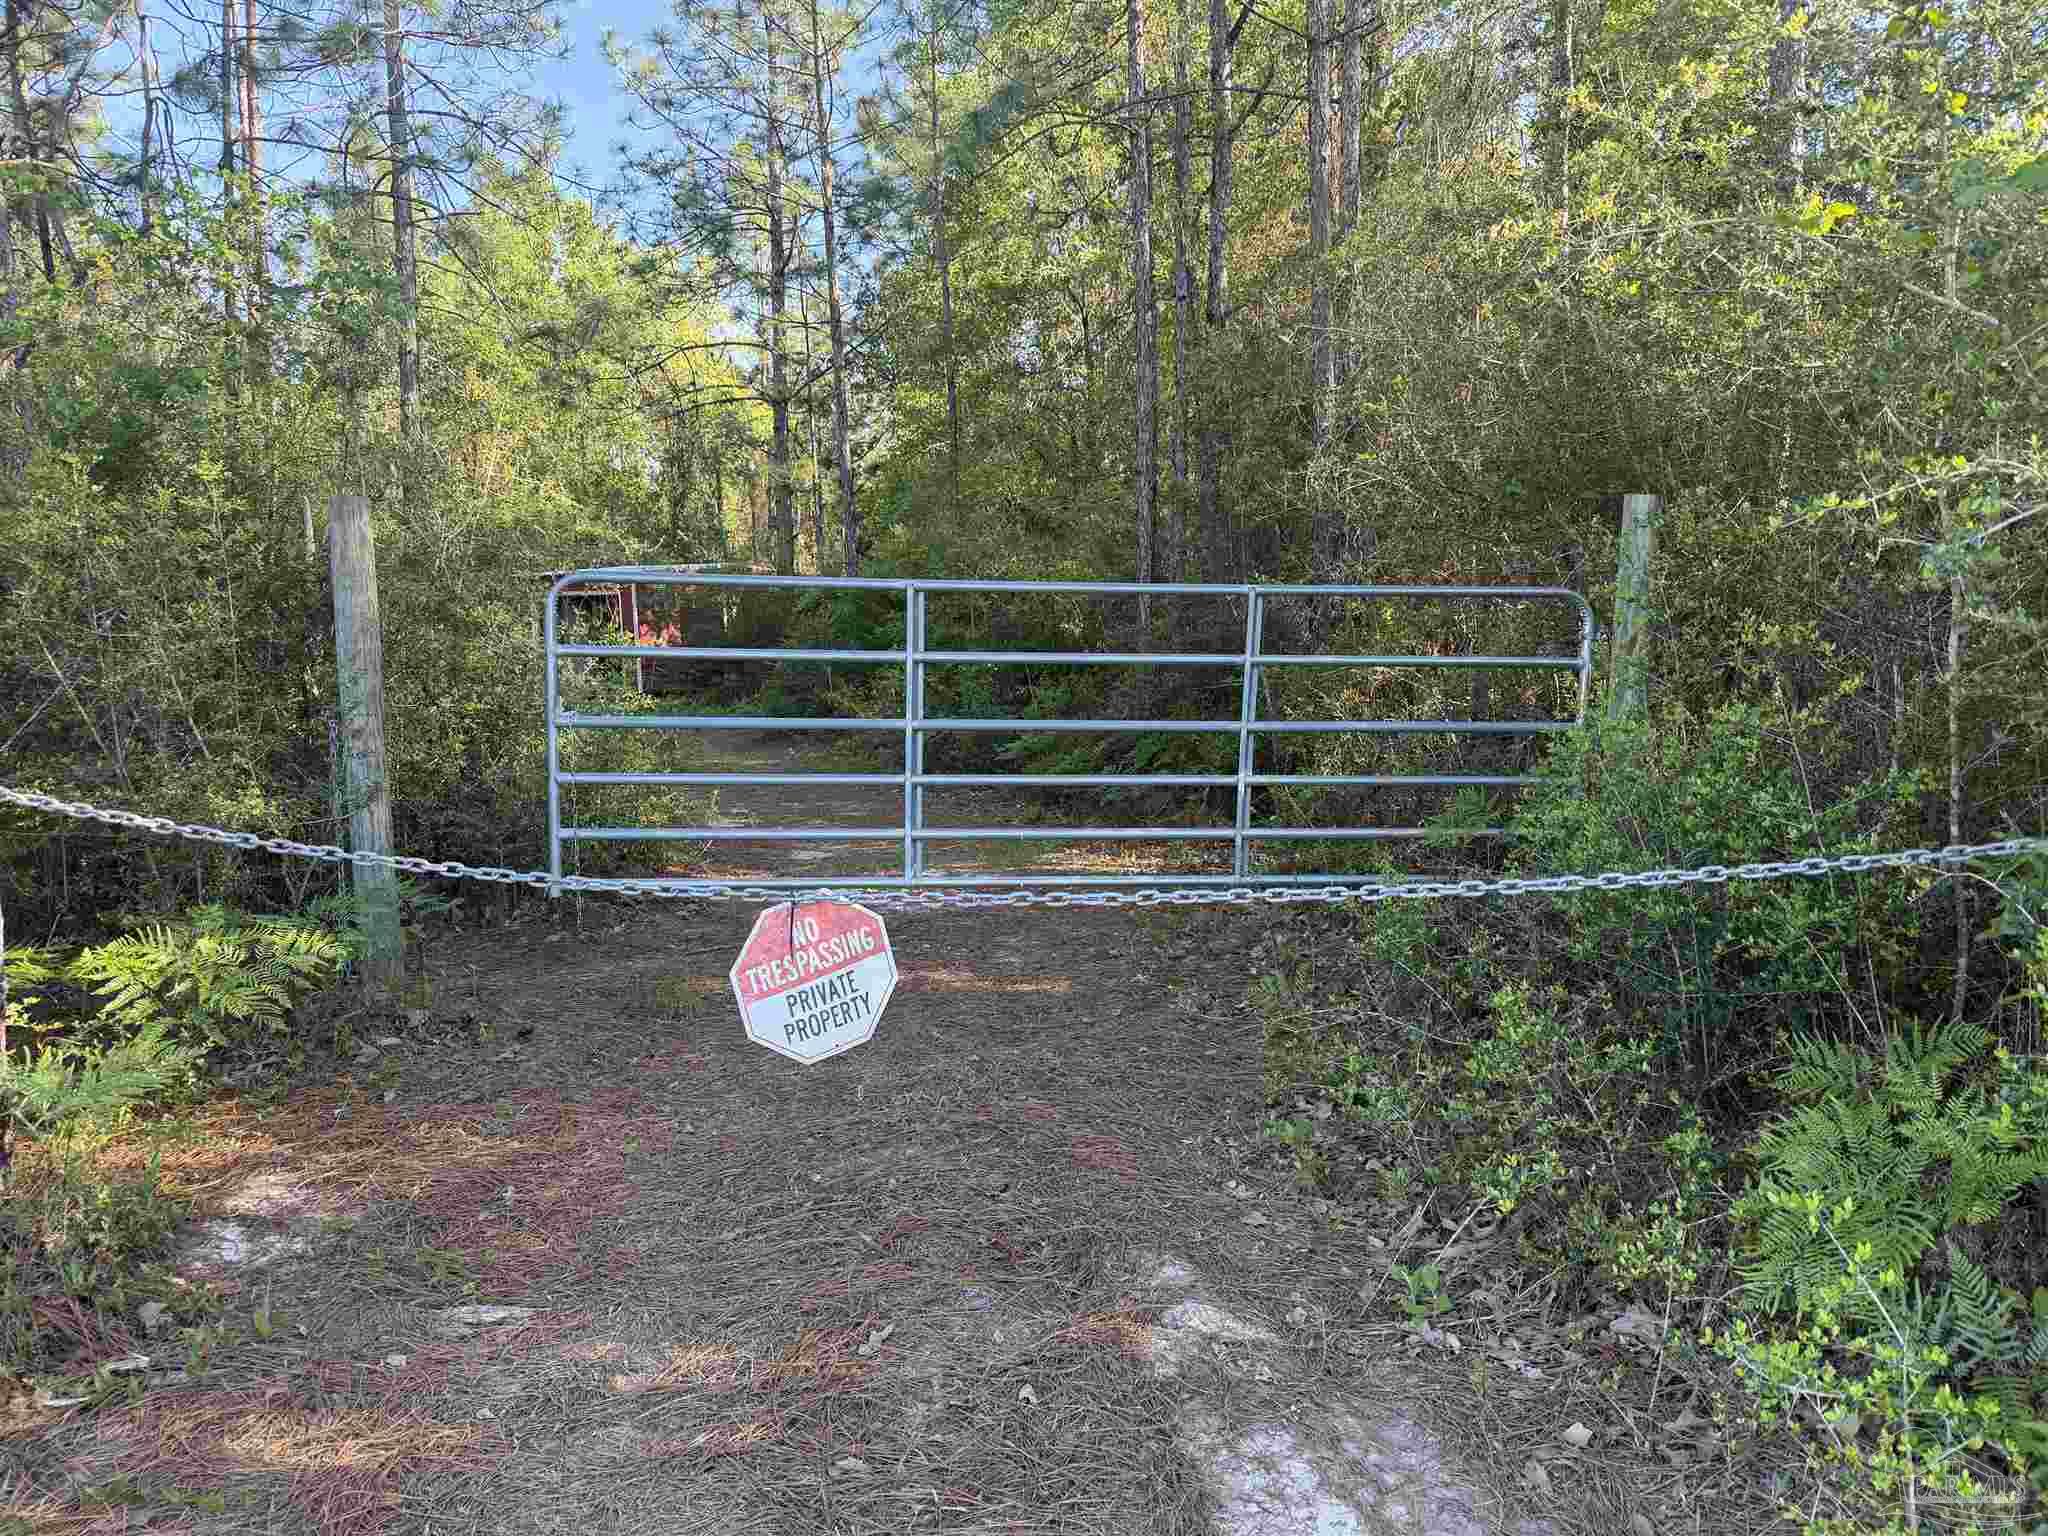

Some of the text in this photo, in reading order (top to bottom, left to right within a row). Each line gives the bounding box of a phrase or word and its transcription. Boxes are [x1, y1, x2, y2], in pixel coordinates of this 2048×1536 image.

[791, 917, 820, 947] NO
[745, 928, 874, 993] TRESPASSING
[783, 992, 871, 1044] PROPERTY
[785, 970, 860, 1017] PRIVATE
